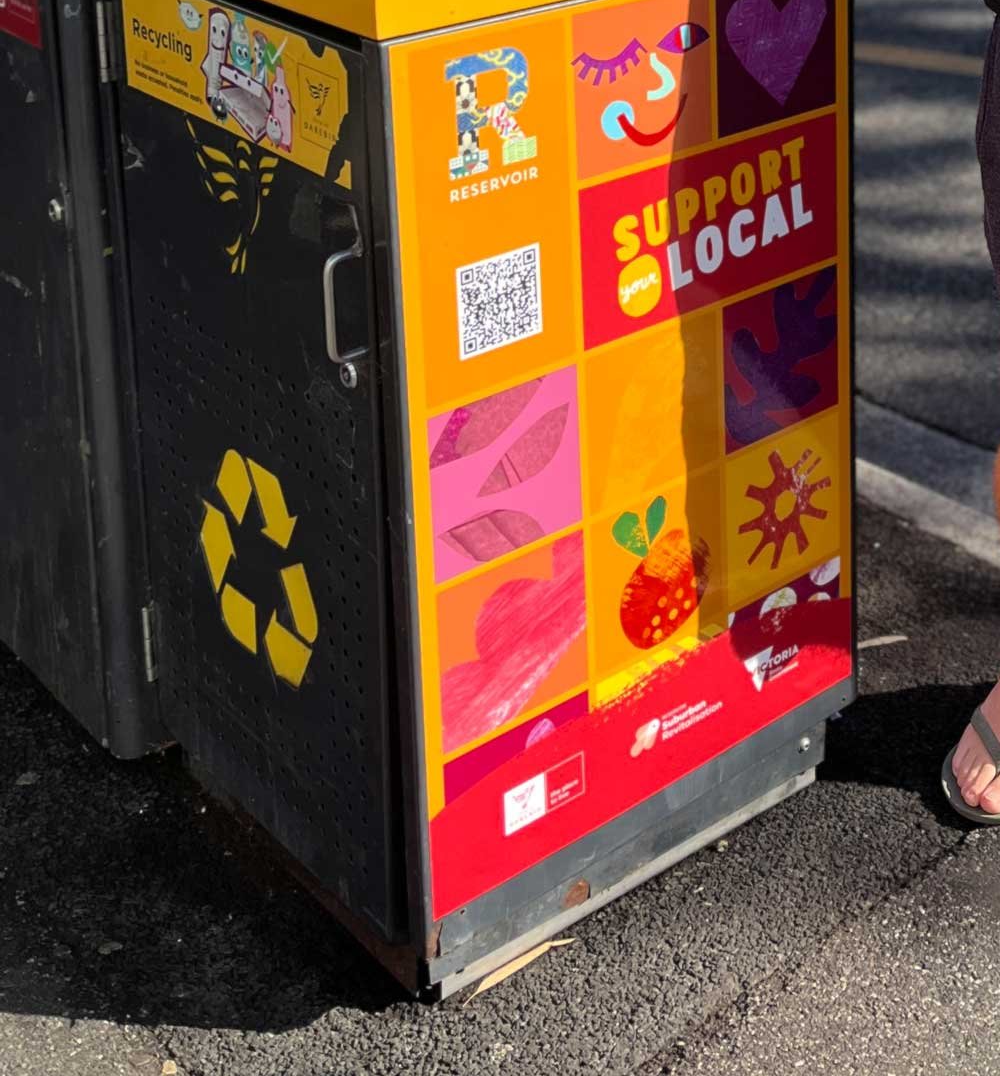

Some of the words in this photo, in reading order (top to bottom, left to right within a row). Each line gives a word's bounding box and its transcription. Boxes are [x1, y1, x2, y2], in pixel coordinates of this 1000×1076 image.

[132, 18, 193, 62] Recycling
[449, 166, 539, 203] RESERVOIR
[612, 135, 805, 263] SUPPORT
[667, 182, 814, 292] LOCAL
[620, 271, 660, 305] your
[662, 700, 707, 731] Suburban
